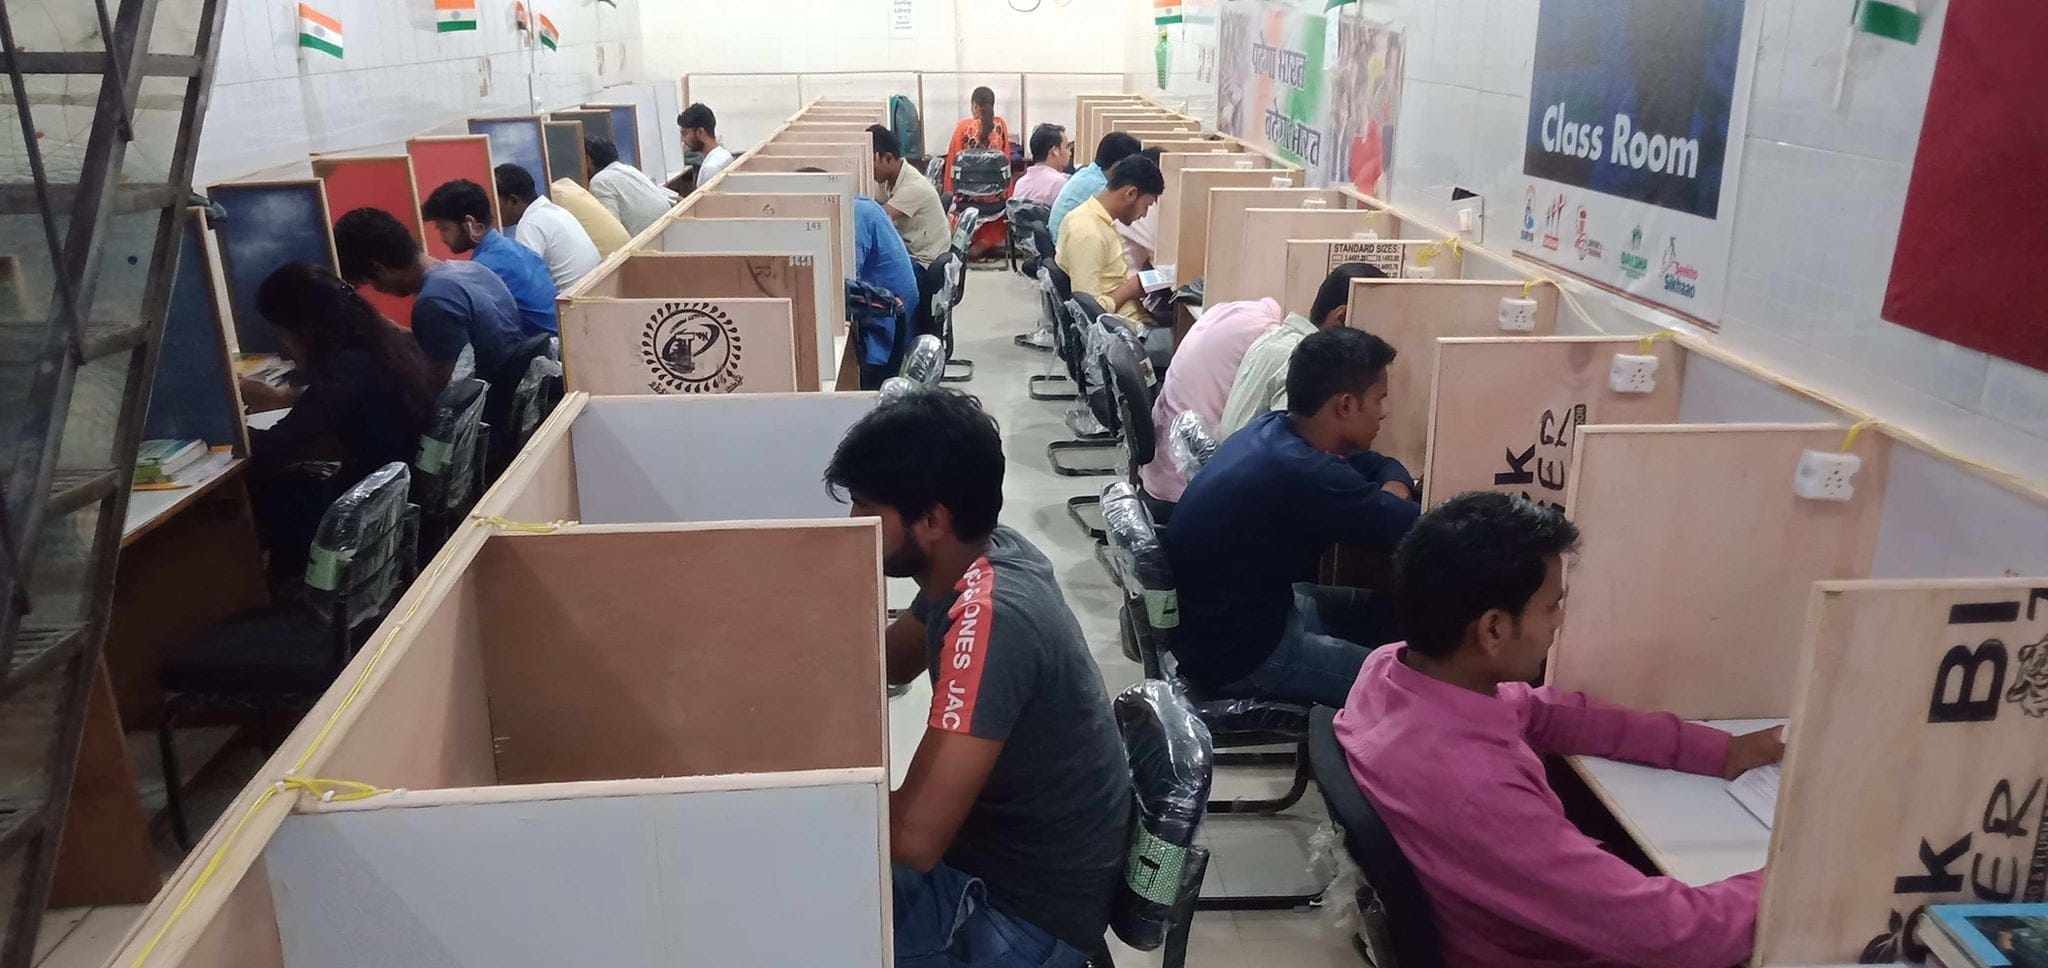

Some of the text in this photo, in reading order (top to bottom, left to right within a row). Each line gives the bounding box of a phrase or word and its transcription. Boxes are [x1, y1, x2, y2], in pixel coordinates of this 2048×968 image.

[1541, 102, 1700, 179] Class Room
[806, 222, 821, 231] 143
[1334, 243, 1375, 253] STANDARD
[792, 255, 809, 266] 144
